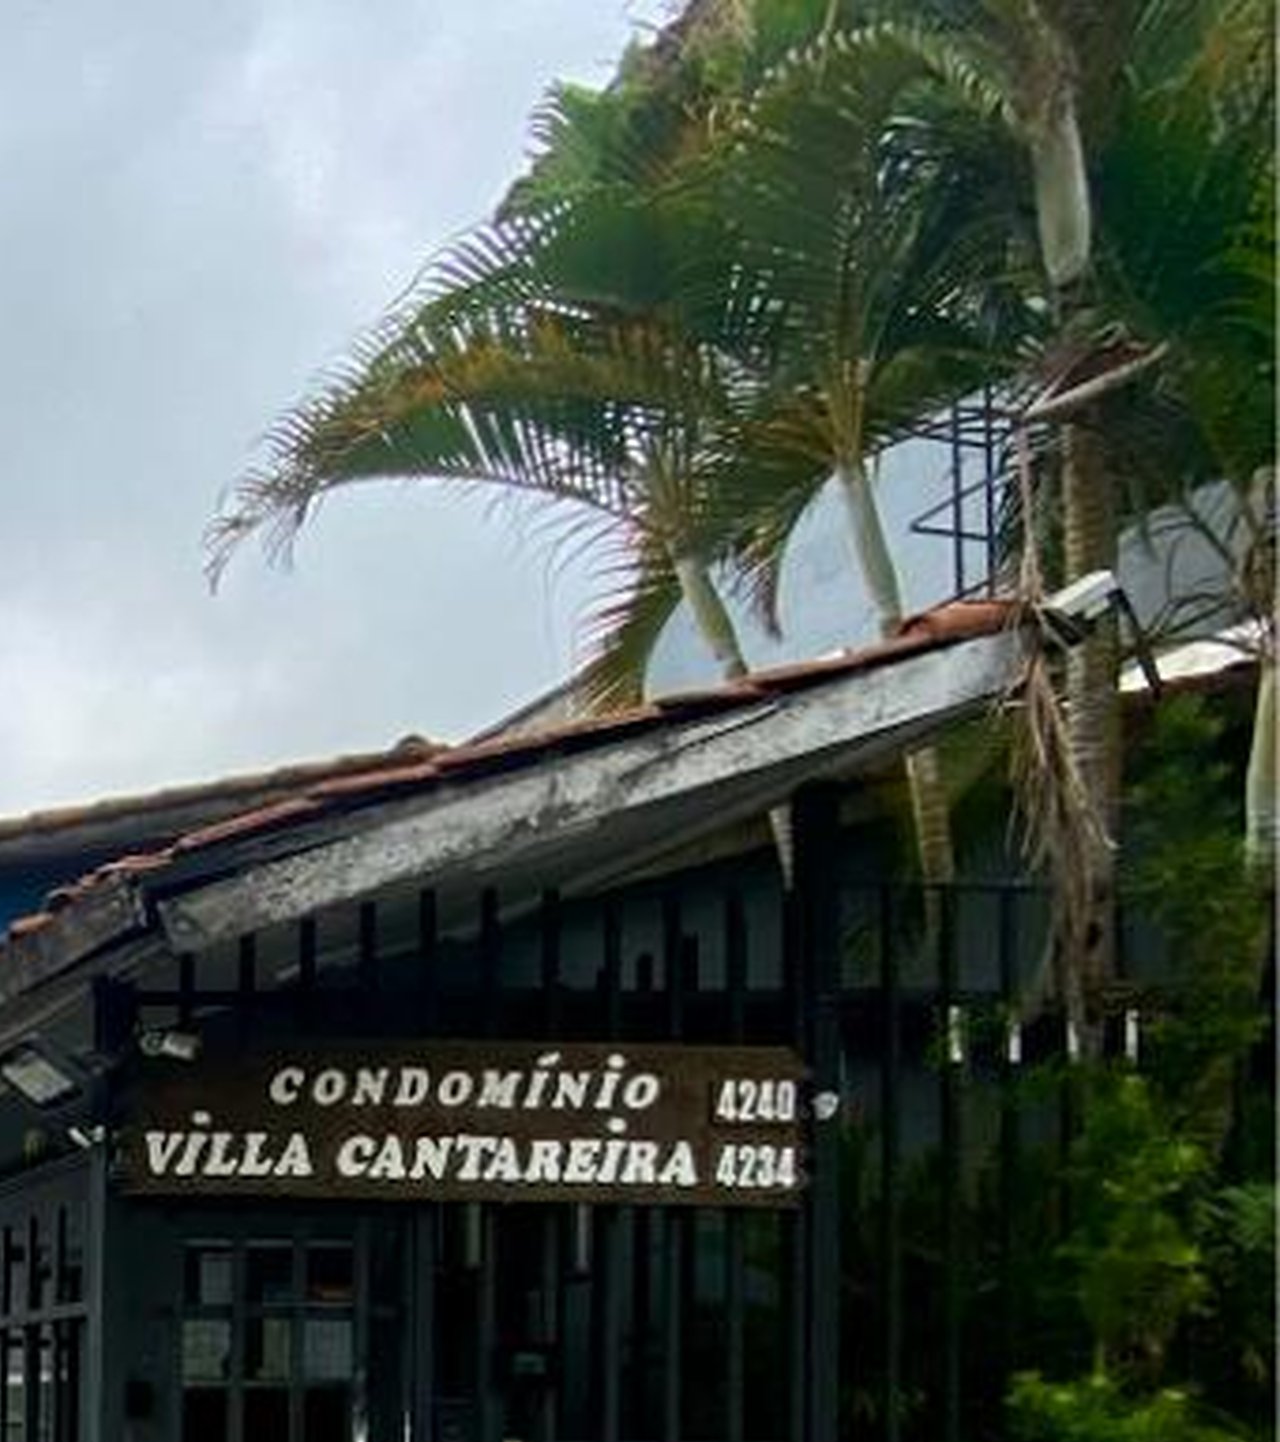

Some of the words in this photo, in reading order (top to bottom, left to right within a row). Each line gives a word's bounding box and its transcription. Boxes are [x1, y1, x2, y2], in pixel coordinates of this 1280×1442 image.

[269, 1053, 660, 1108] CONDOMÍNIO
[716, 1080, 796, 1121] 4240
[145, 1111, 313, 1176] VILLA
[336, 1117, 697, 1187] CANTAREIRA
[715, 1145, 796, 1187] 4234
